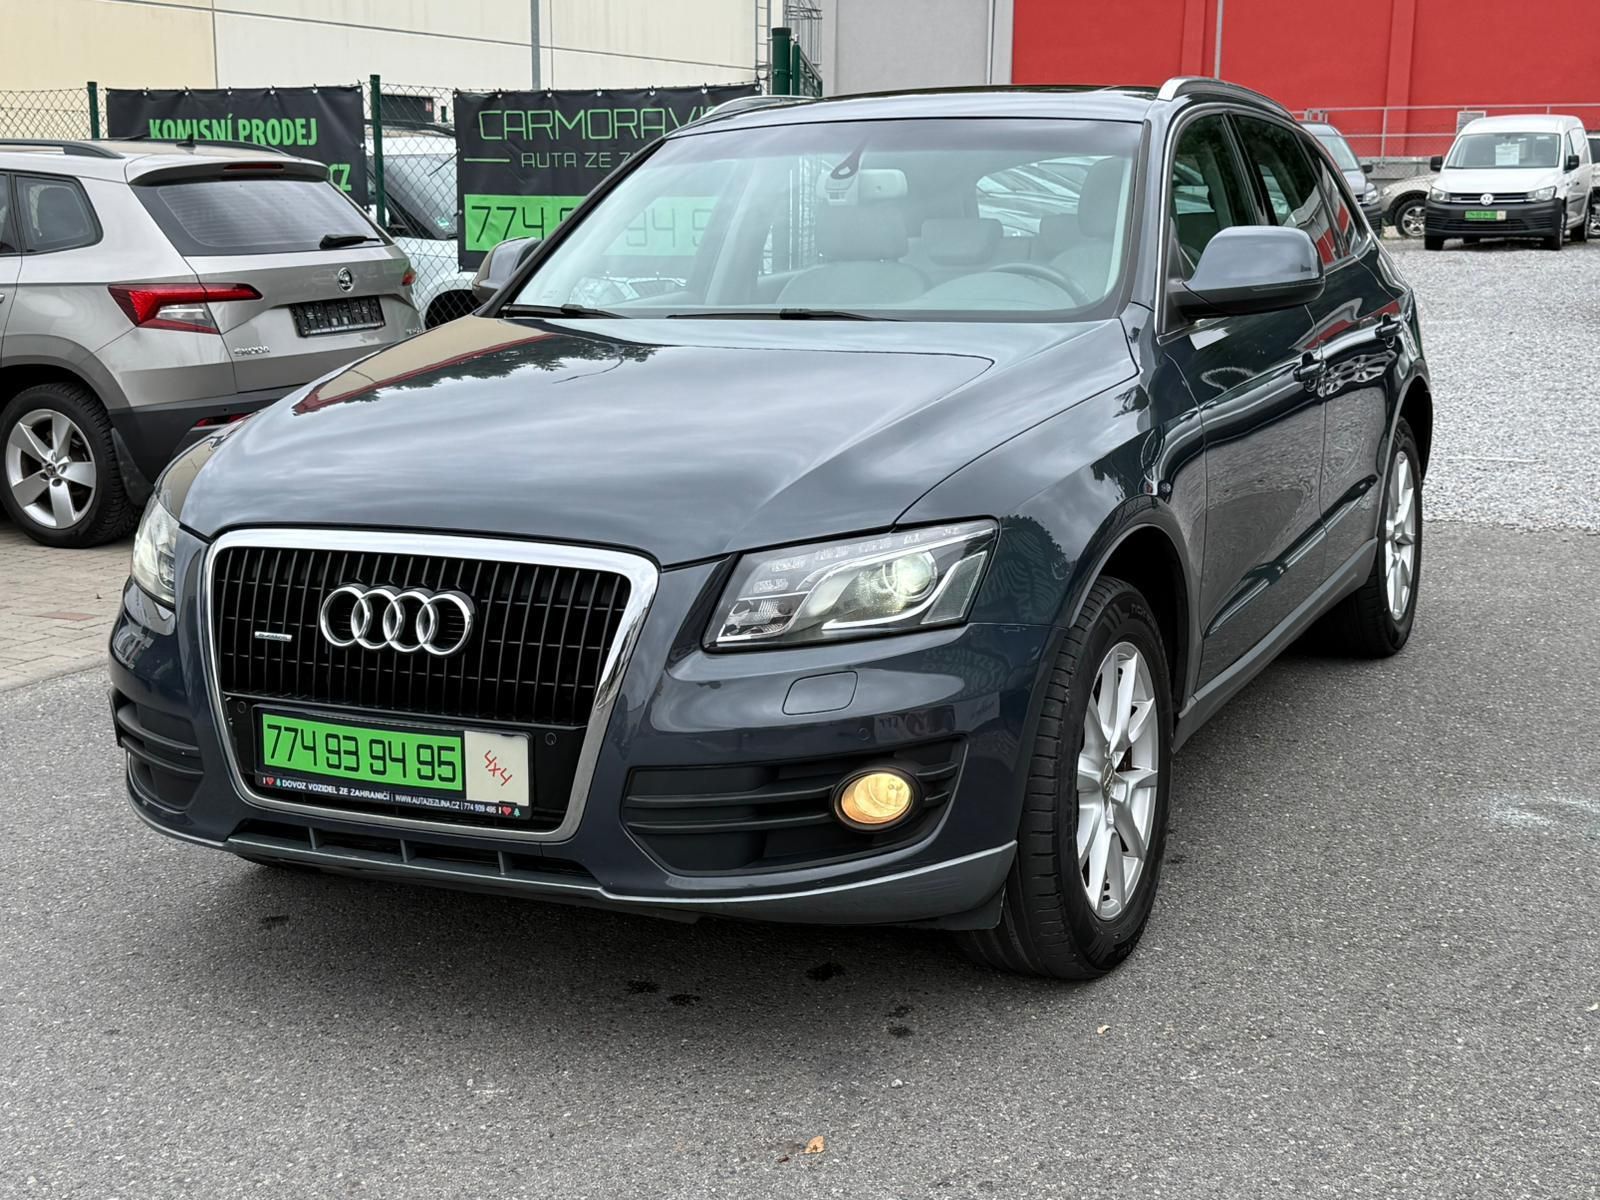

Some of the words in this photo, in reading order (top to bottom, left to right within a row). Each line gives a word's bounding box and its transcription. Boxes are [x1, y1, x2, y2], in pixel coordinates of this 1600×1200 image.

[149, 113, 233, 141] KOMISNÍ
[238, 118, 318, 146] PRODEJ
[521, 152, 577, 168] AUTA
[584, 152, 612, 168] ZE
[471, 205, 545, 243] 774
[267, 724, 318, 766] 774
[325, 733, 360, 773] 93
[369, 738, 407, 779] 94
[416, 743, 457, 783] 95
[282, 779, 307, 791] DOVOZ
[308, 783, 337, 794] VOZIDEL
[339, 786, 349, 796] ZE
